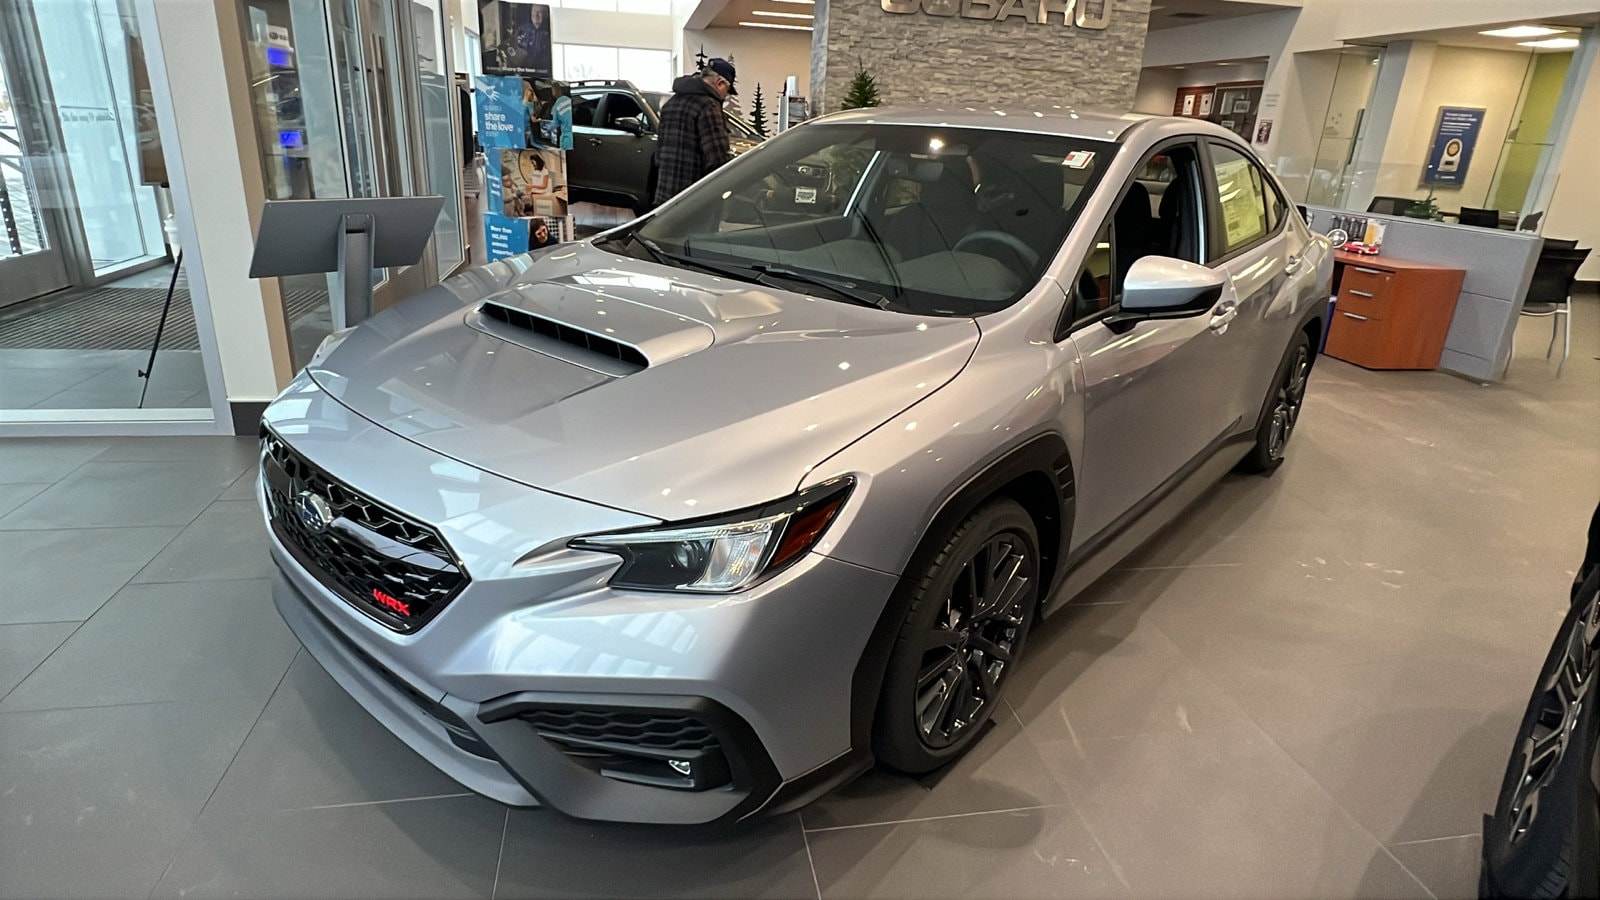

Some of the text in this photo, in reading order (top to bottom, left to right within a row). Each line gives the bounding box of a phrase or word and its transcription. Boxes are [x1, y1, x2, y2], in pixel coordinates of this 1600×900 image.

[484, 112, 506, 122] share
[486, 120, 514, 132] the love
[373, 588, 410, 617] WRX
